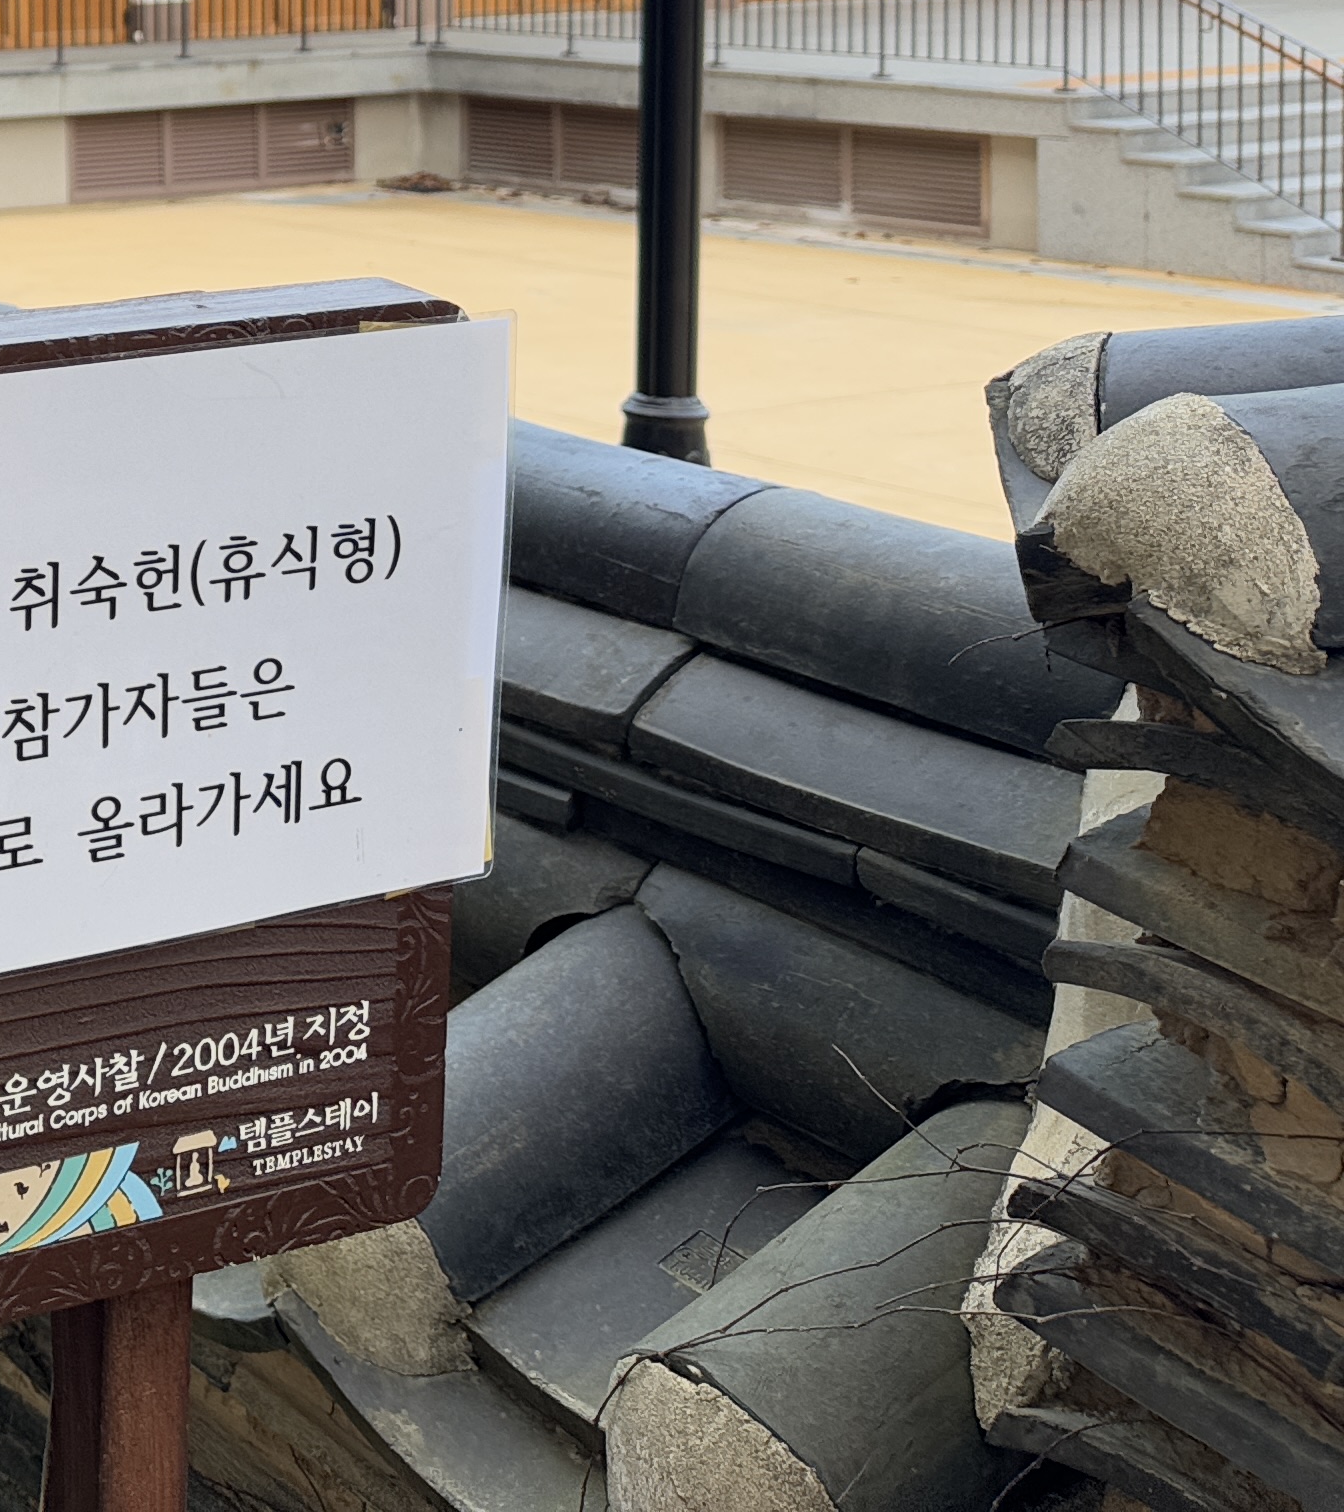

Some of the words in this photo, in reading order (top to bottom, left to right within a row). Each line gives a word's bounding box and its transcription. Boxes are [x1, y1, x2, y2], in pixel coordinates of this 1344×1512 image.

[9, 514, 401, 632] 취숙헌(휴식형)
[1, 657, 296, 762] 참가자들은
[77, 757, 363, 863] 올라가세요
[302, 999, 371, 1046] 지정
[49, 1103, 108, 1130] Corps
[113, 1093, 134, 1116] of
[138, 1083, 203, 1110] Korean
[207, 1062, 294, 1095] Buddhism
[295, 1053, 315, 1075] in
[319, 1042, 368, 1070] 2004
[238, 1091, 379, 1154] 템플스테이
[252, 1134, 365, 1176] TEMPLESTAY
